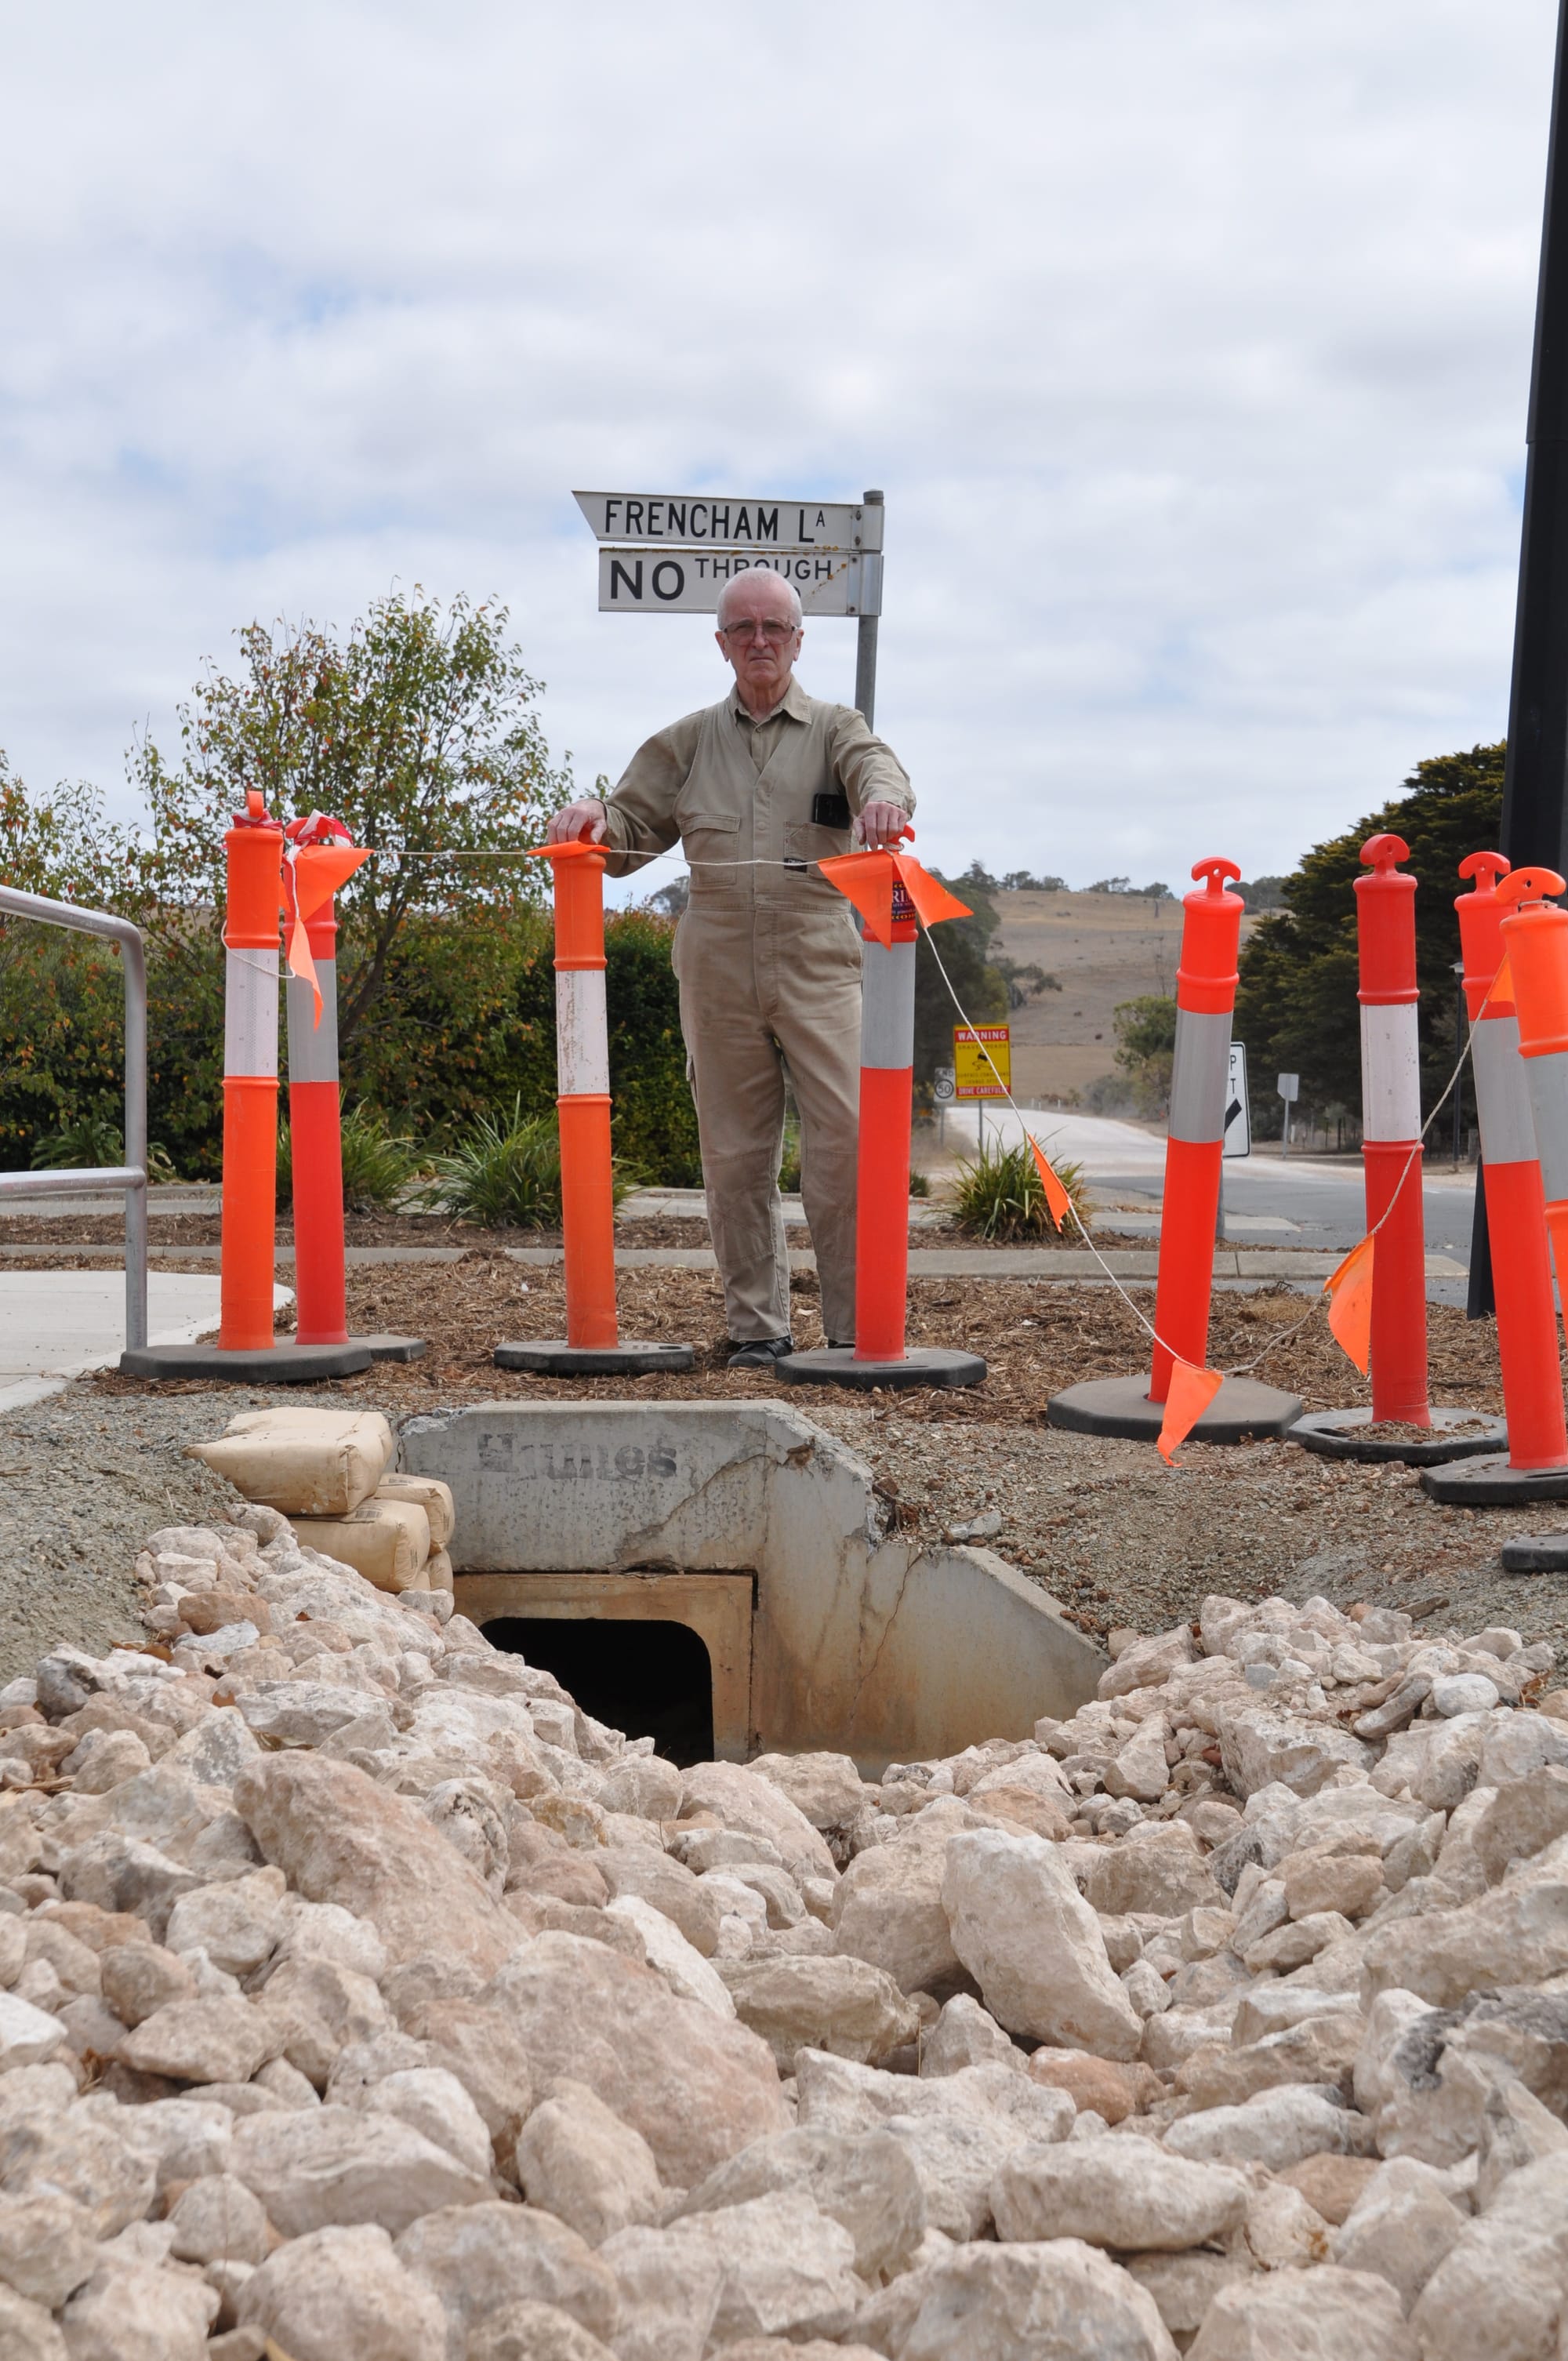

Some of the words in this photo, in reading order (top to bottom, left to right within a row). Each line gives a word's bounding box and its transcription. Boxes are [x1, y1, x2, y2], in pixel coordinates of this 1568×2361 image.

[605, 499, 779, 541] FRENCHAM
[610, 560, 685, 601] NO
[958, 1030, 1007, 1041] WARNING
[938, 1084, 951, 1094] 50
[959, 1087, 974, 1095] DRIVE
